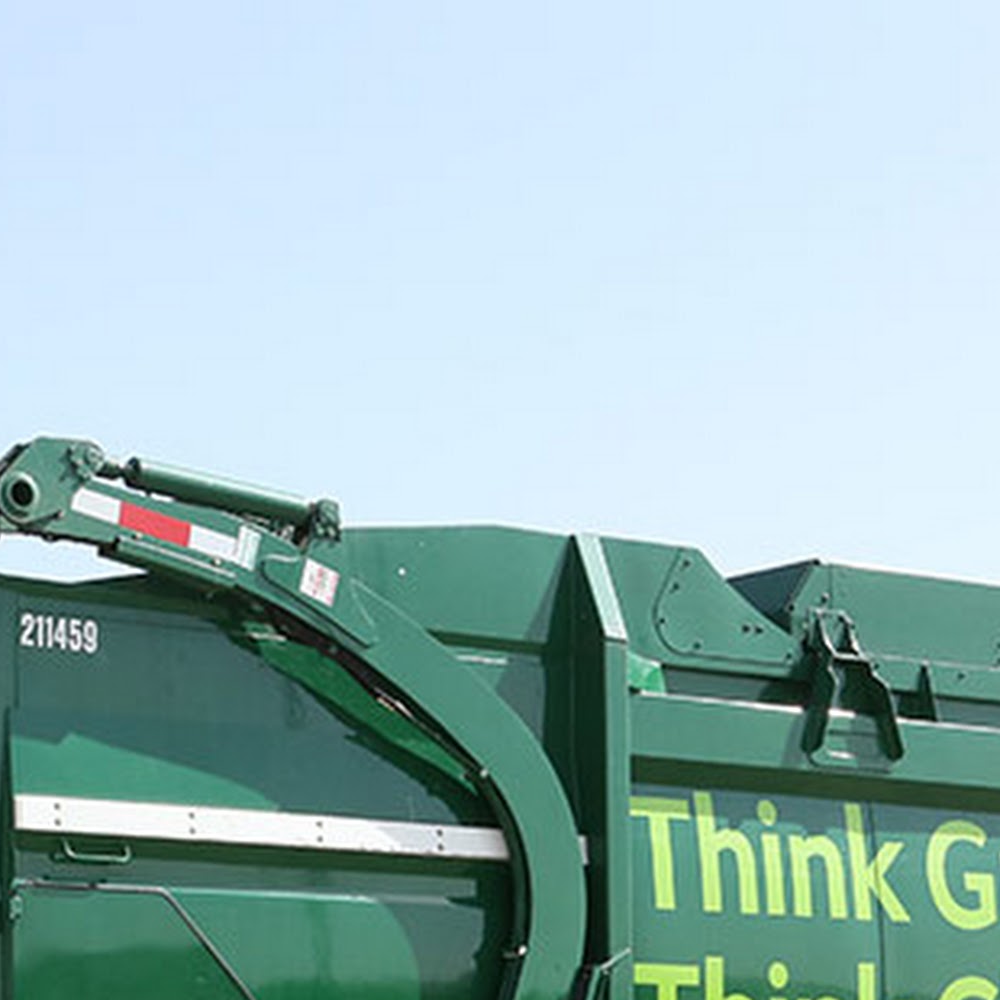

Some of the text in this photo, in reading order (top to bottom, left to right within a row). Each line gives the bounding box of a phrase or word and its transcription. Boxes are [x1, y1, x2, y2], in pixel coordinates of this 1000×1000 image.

[20, 612, 98, 654] 211459
[629, 790, 1000, 931] Think G
